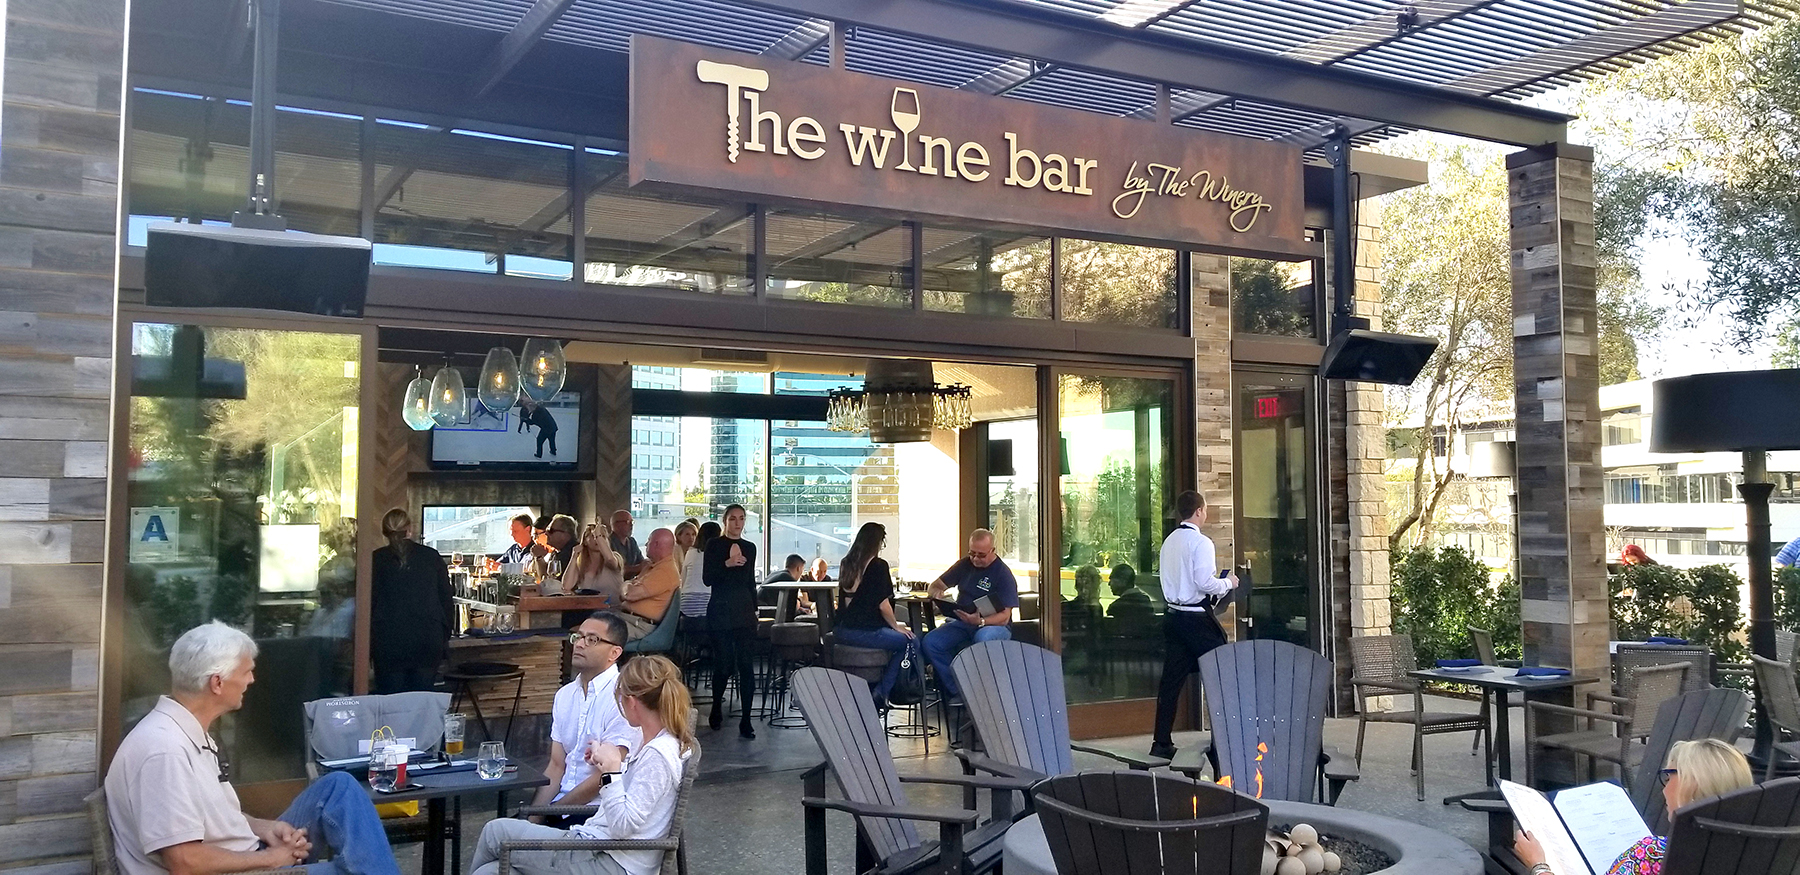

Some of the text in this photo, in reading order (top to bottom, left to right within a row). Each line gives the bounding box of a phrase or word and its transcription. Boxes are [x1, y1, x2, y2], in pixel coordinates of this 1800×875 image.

[696, 59, 1098, 196] The wine bar
[1112, 160, 1273, 233] by The Winery
[1258, 397, 1278, 418] EXIT
[140, 514, 169, 542] A
